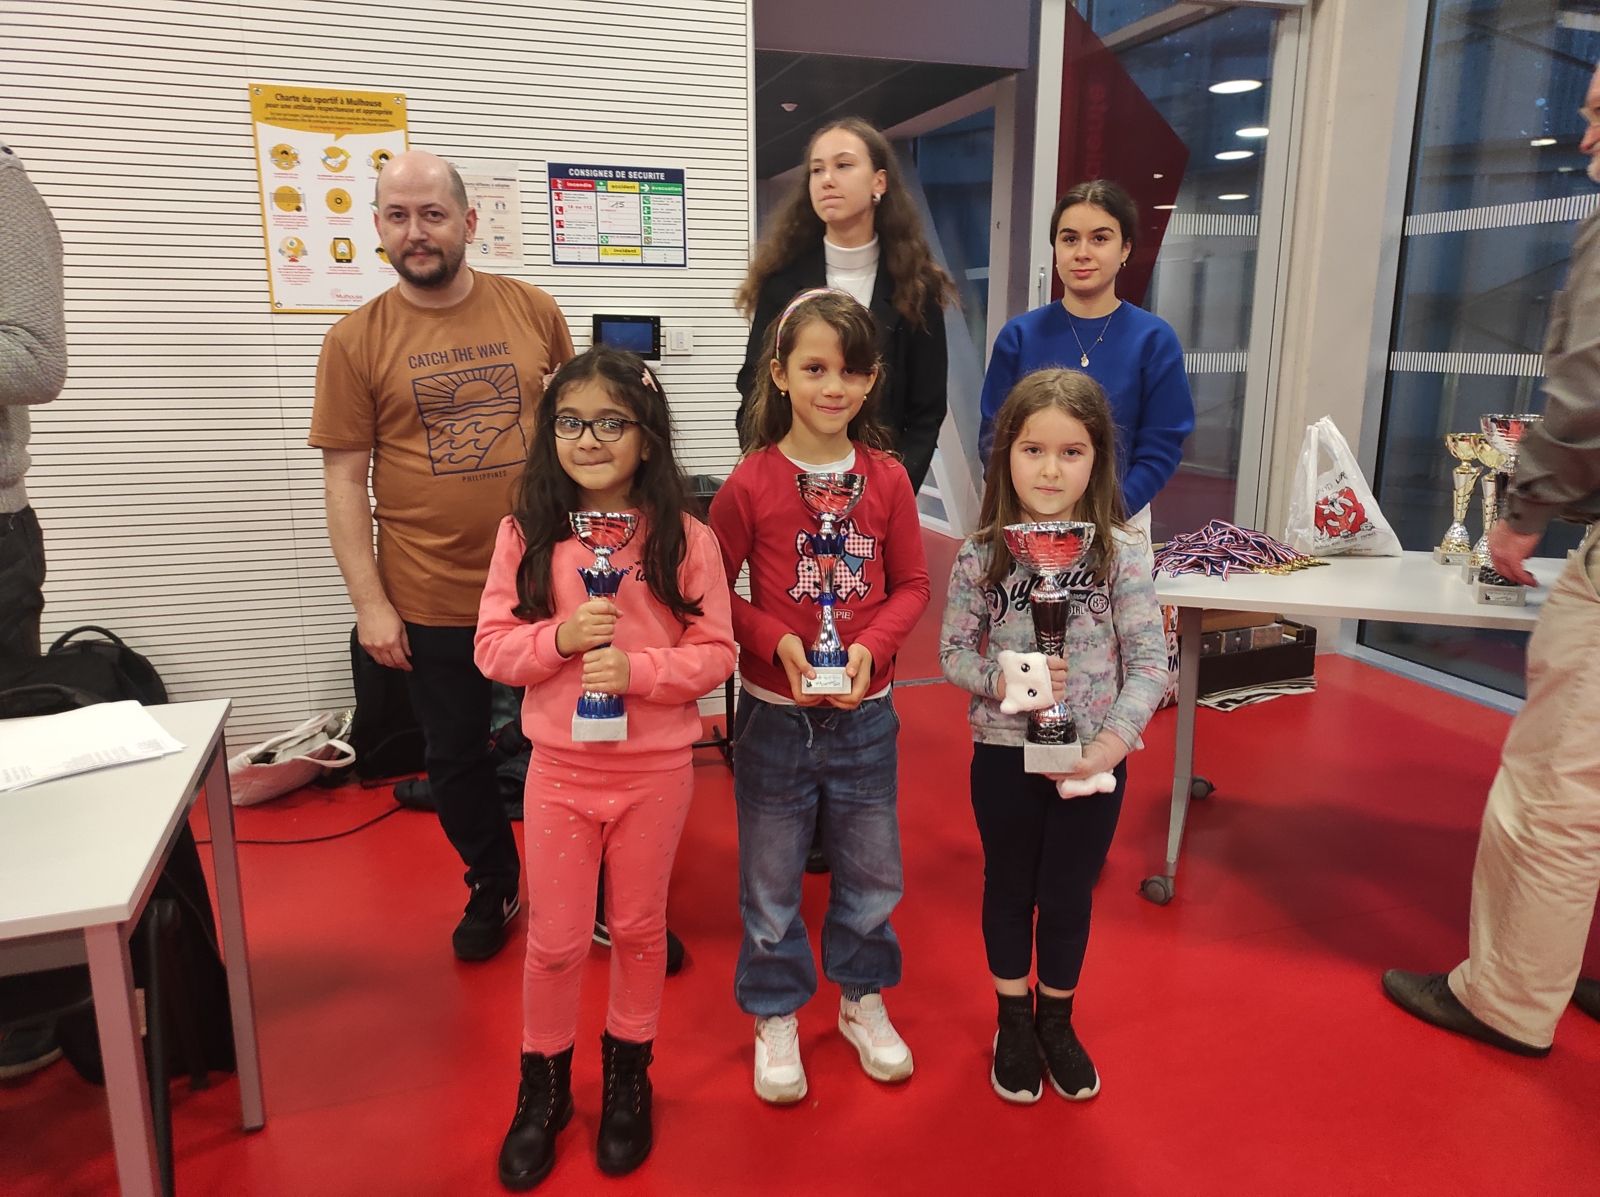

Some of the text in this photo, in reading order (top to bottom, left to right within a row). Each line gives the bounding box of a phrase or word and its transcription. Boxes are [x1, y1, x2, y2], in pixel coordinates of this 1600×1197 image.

[275, 93, 300, 102] Charte
[302, 95, 312, 103] du
[313, 96, 339, 105] sportif
[346, 98, 382, 107] Mulhouse
[568, 168, 665, 180] CONSIGNES DE SECURITE
[408, 341, 510, 369] CATCH THE WAVE
[462, 470, 507, 482] PHILIPPINES
